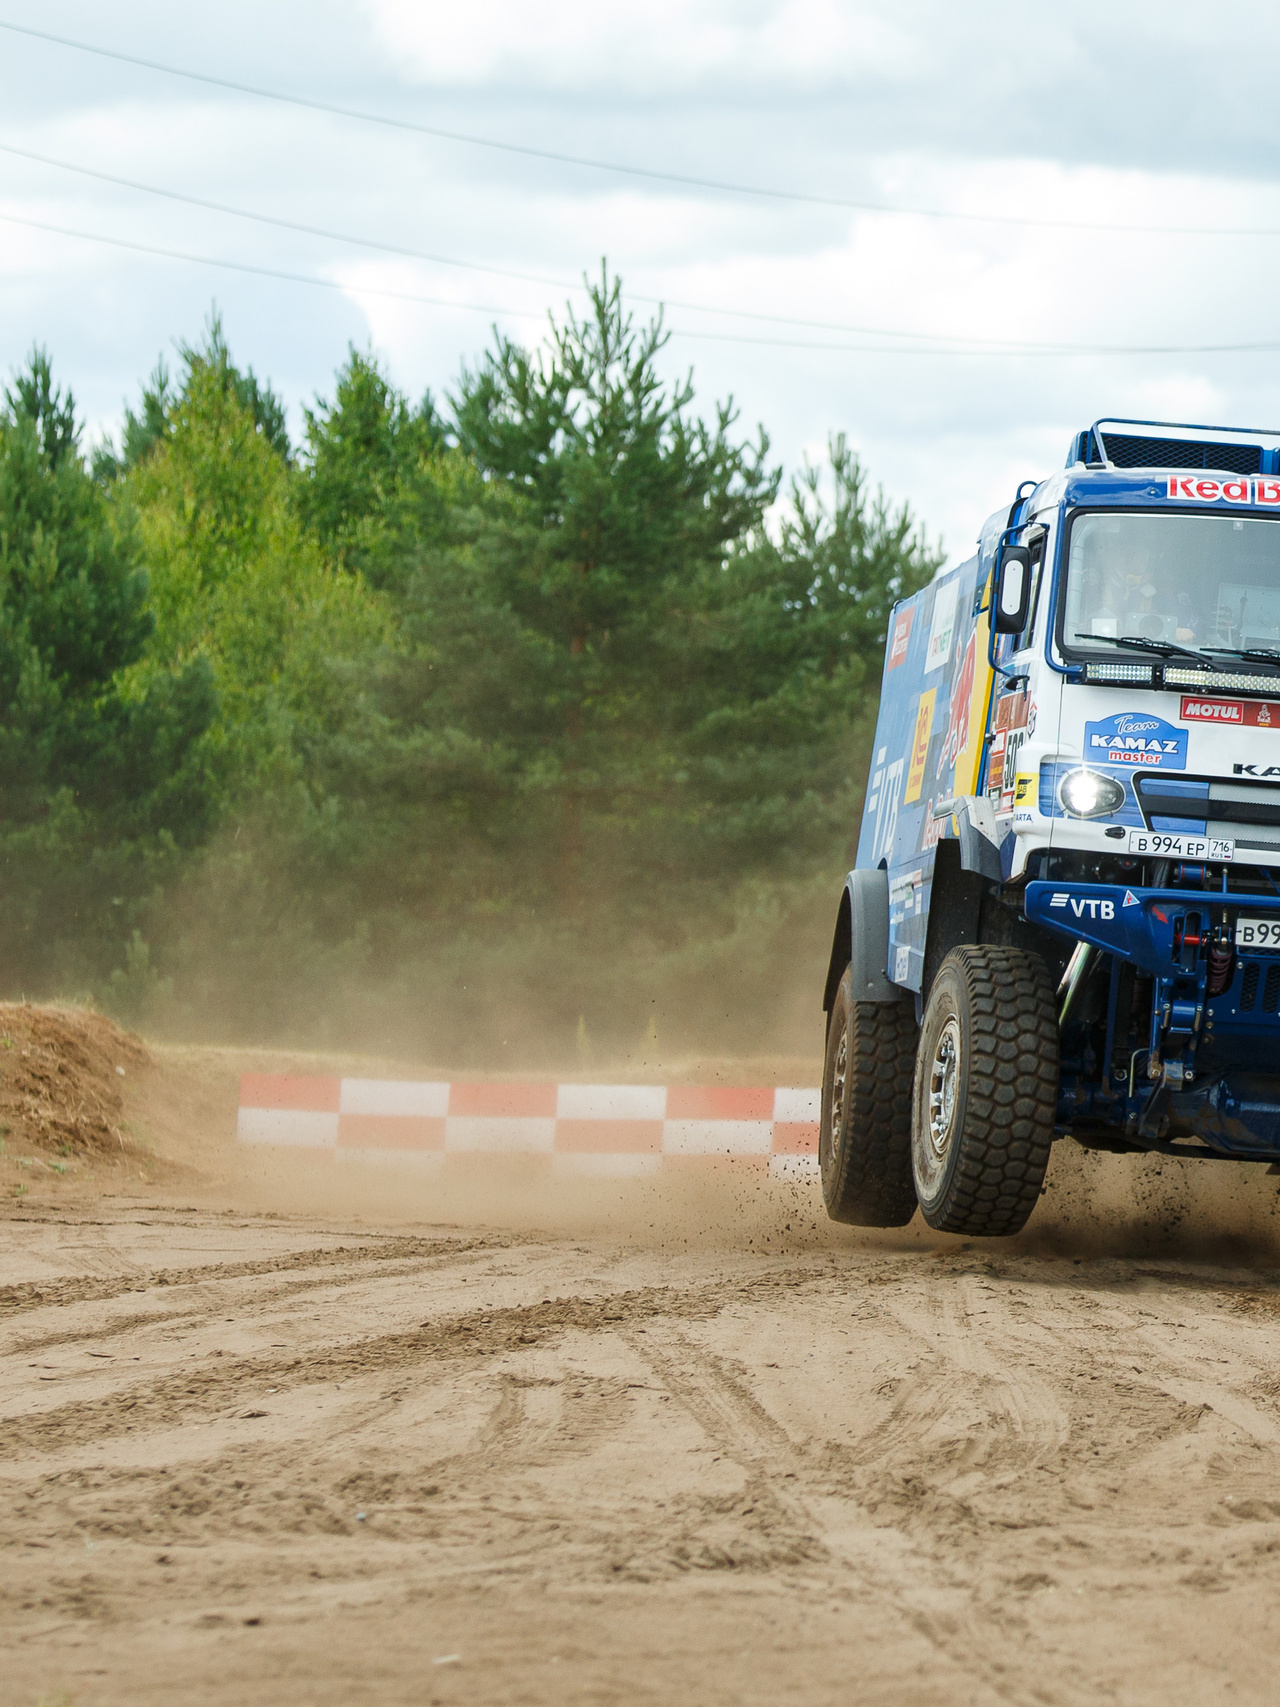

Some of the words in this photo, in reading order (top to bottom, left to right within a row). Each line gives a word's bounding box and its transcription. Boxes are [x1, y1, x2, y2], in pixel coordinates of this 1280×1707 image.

[1169, 475, 1248, 501] Red
[1185, 702, 1240, 719] MOTUL
[1114, 714, 1159, 734] Team
[1091, 734, 1179, 754] KAMAZ
[1109, 750, 1162, 764] master
[872, 757, 905, 860] VTB
[1212, 841, 1230, 853] 716
[1069, 898, 1115, 920] VTB
